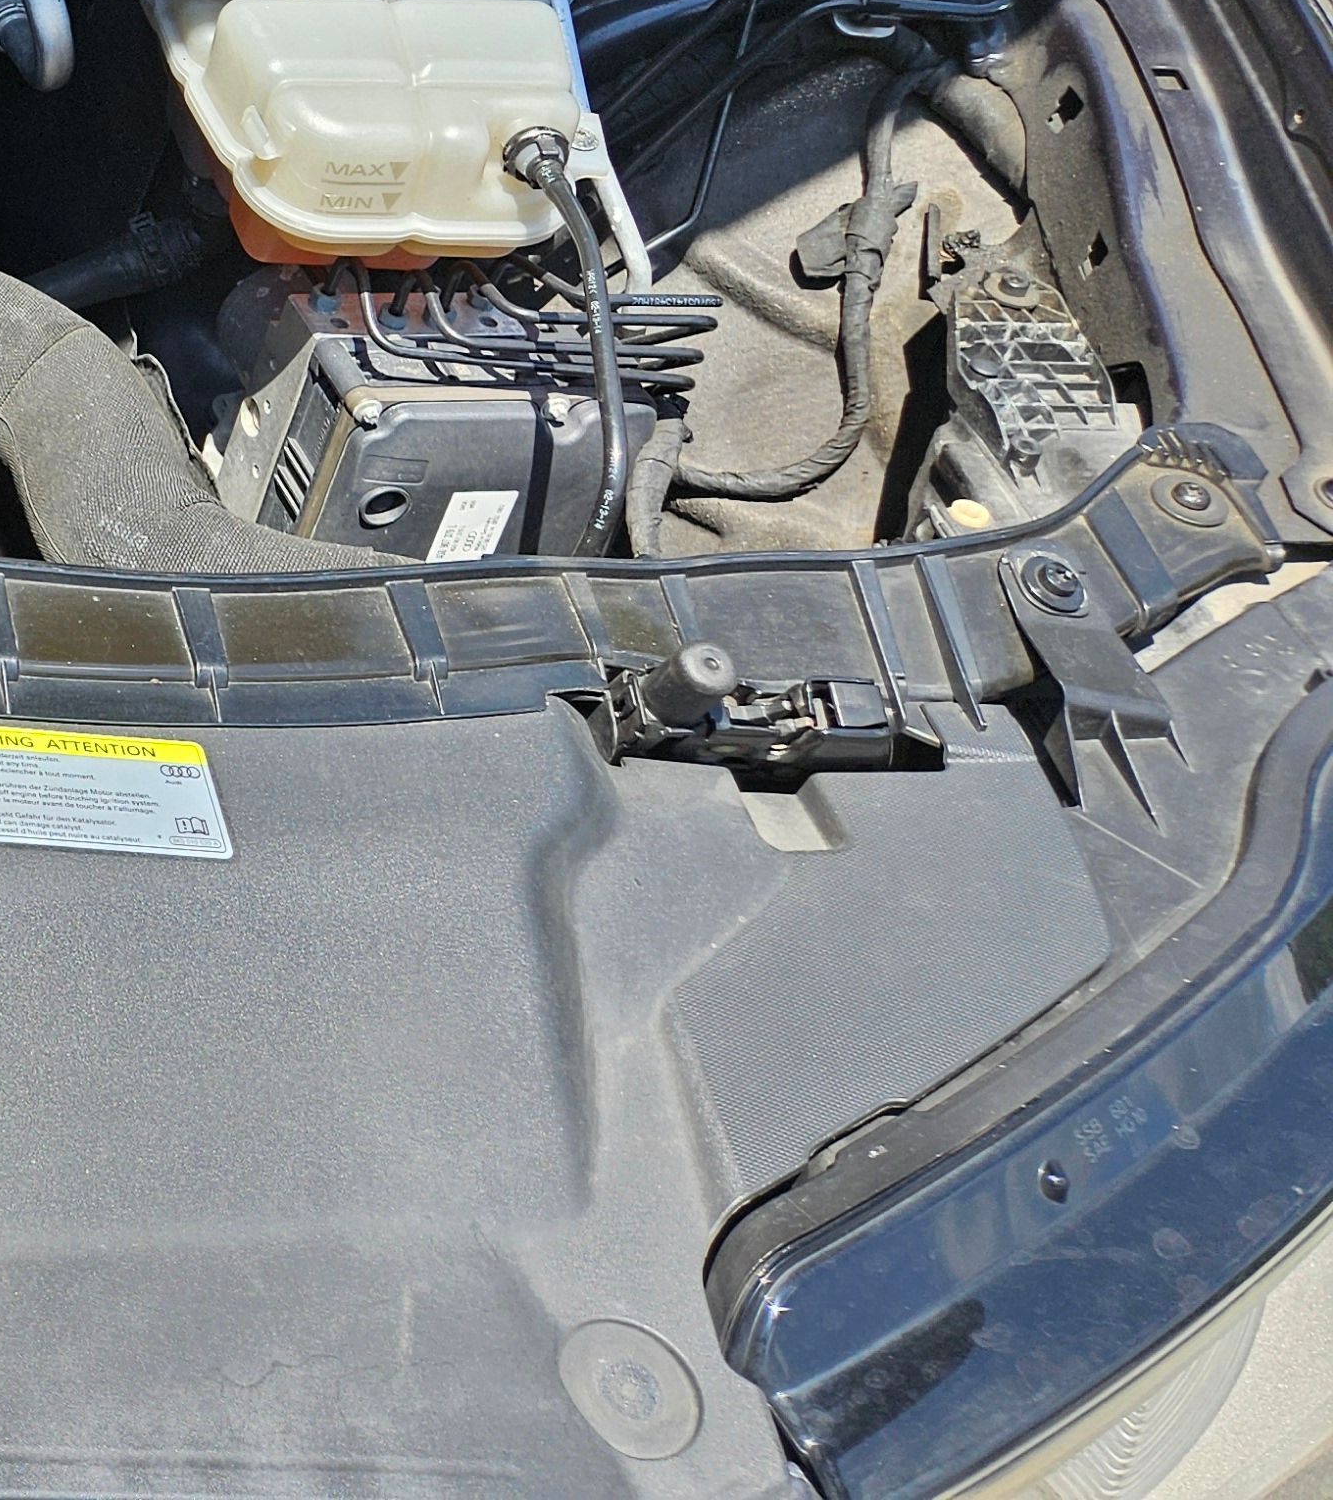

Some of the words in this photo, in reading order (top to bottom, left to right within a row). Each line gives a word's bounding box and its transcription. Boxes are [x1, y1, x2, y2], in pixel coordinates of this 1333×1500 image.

[325, 161, 386, 176] MAX
[320, 194, 373, 209] MIN
[47, 739, 157, 758] ATTENTION
